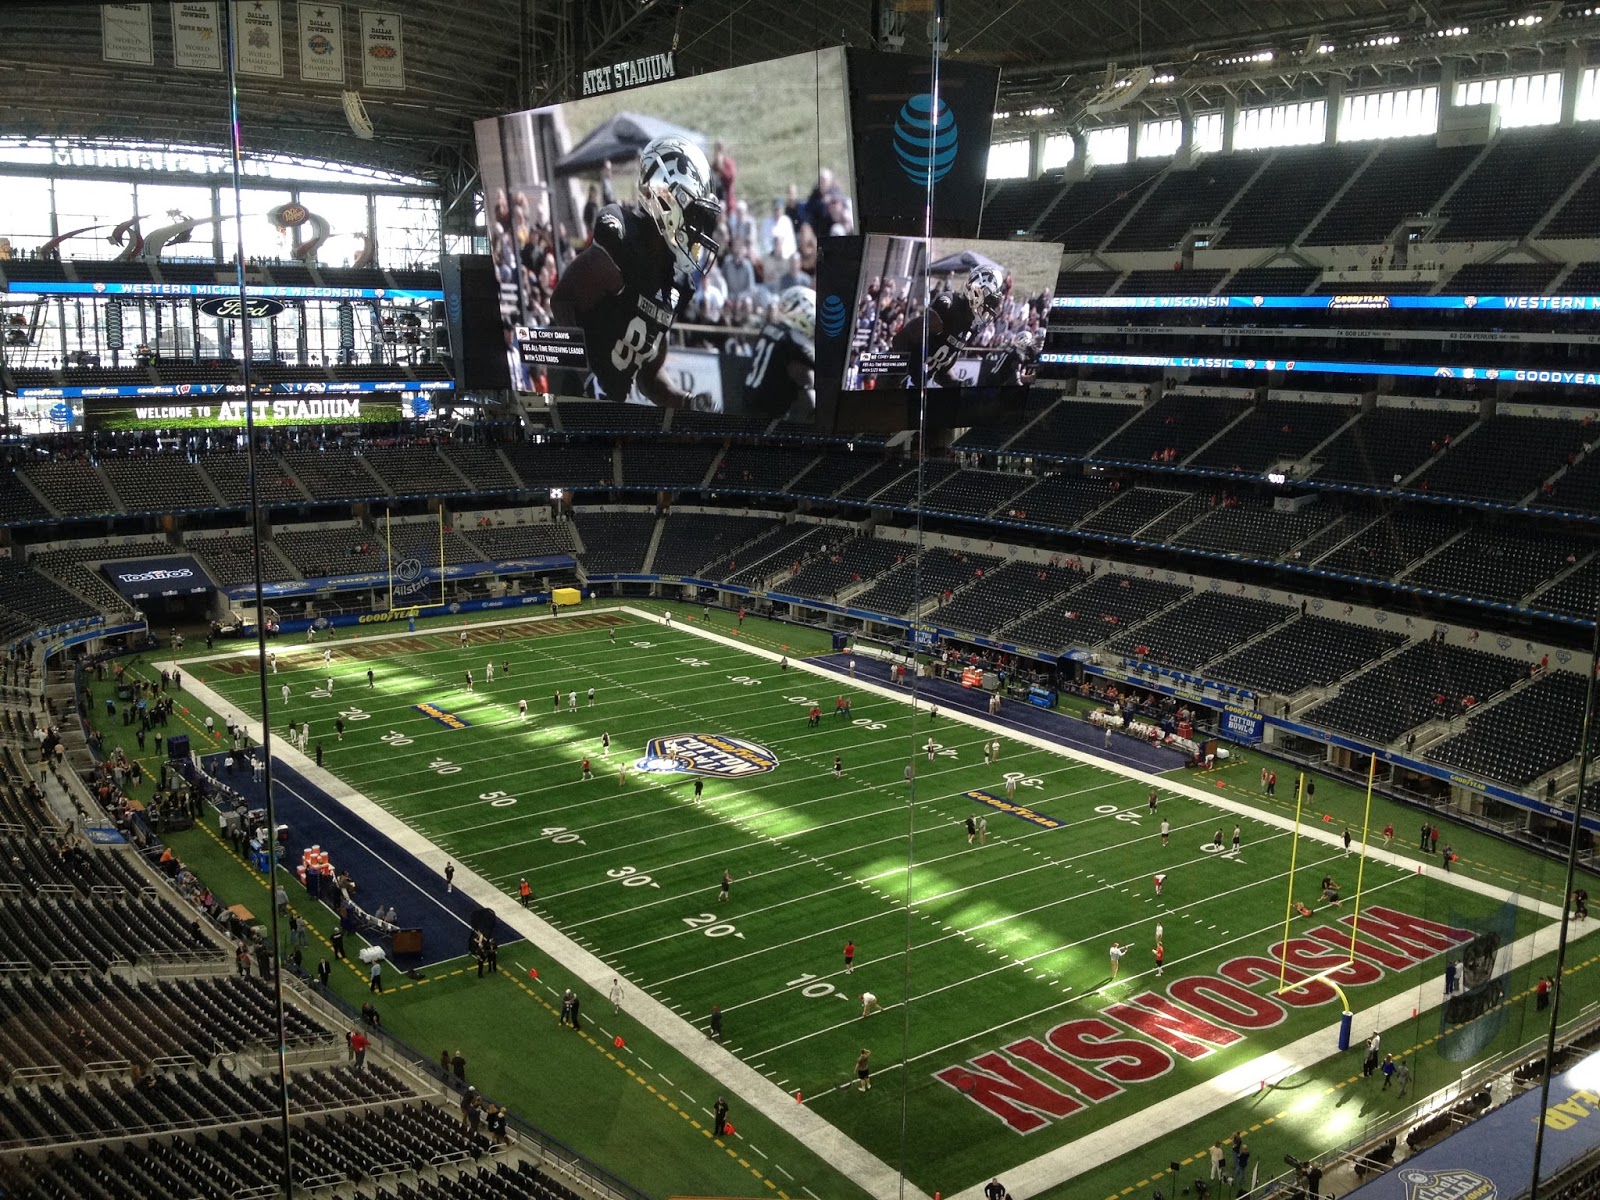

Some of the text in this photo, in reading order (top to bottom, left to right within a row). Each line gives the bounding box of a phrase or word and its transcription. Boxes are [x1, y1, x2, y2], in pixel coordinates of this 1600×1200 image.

[183, 5, 207, 13] DALLAS
[180, 11, 211, 20] COWBOYS
[247, 12, 270, 20] DALLAS
[245, 18, 273, 28] COWBOYS
[309, 20, 332, 28] DALLAS
[307, 26, 334, 34] COWBOYS
[369, 34, 396, 42] COWBOYS
[249, 51, 272, 60] WORLD
[311, 57, 334, 66] WORLD
[241, 57, 280, 67] CHAMPIONS
[304, 64, 341, 74] CHAMPIONS
[582, 51, 676, 95] AT&T STADIUM
[366, 71, 402, 80] CHAMPIONS
[121, 284, 363, 297] WESTERN MICHIAN VS WISCONSIN
[1141, 297, 1156, 307] VS
[1160, 297, 1230, 307] WISCONSIN
[1334, 295, 1386, 304] GOODYEAR
[1505, 297, 1586, 309] WESTERN
[215, 299, 270, 316] Ford
[538, 331, 554, 339] COREY
[554, 332, 570, 340] DAVIS
[531, 344, 548, 352] ALL-TIME
[548, 345, 569, 354] RECEIVING
[569, 347, 584, 355] LEADER
[524, 354, 535, 362] WITH
[546, 356, 560, 364] YARDS
[1041, 354, 1234, 368] ODYEAR COTTON BOWL CLASSIC
[1515, 370, 1600, 385] GOODYEA
[137, 386, 174, 394] GOODYEAR
[135, 407, 192, 419] WELCOME
[197, 406, 211, 417] TO
[273, 398, 361, 419] STADIUM
[327, 574, 400, 585] GOODYEA
[392, 575, 430, 597] Allstate
[358, 610, 420, 624] GOODYEAR
[338, 709, 372, 721] 20
[1224, 705, 1263, 721] GOODYEAR
[852, 718, 888, 730] 50
[1228, 721, 1248, 732] BOWL
[1229, 714, 1256, 728] COTTON
[380, 733, 414, 746] 30
[697, 735, 774, 767] GOODYEAR
[428, 761, 463, 775] 40
[1449, 774, 1486, 792] GOODYEAR
[479, 790, 518, 807] 50
[967, 791, 1059, 828] GOODYEAR
[1094, 805, 1143, 821] 20
[540, 827, 580, 844] 40
[606, 866, 652, 887] 30
[682, 913, 736, 938] 20
[786, 973, 836, 998] 10
[930, 905, 1481, 1136] WISCONSIN
[1433, 1174, 1482, 1200] COTT
